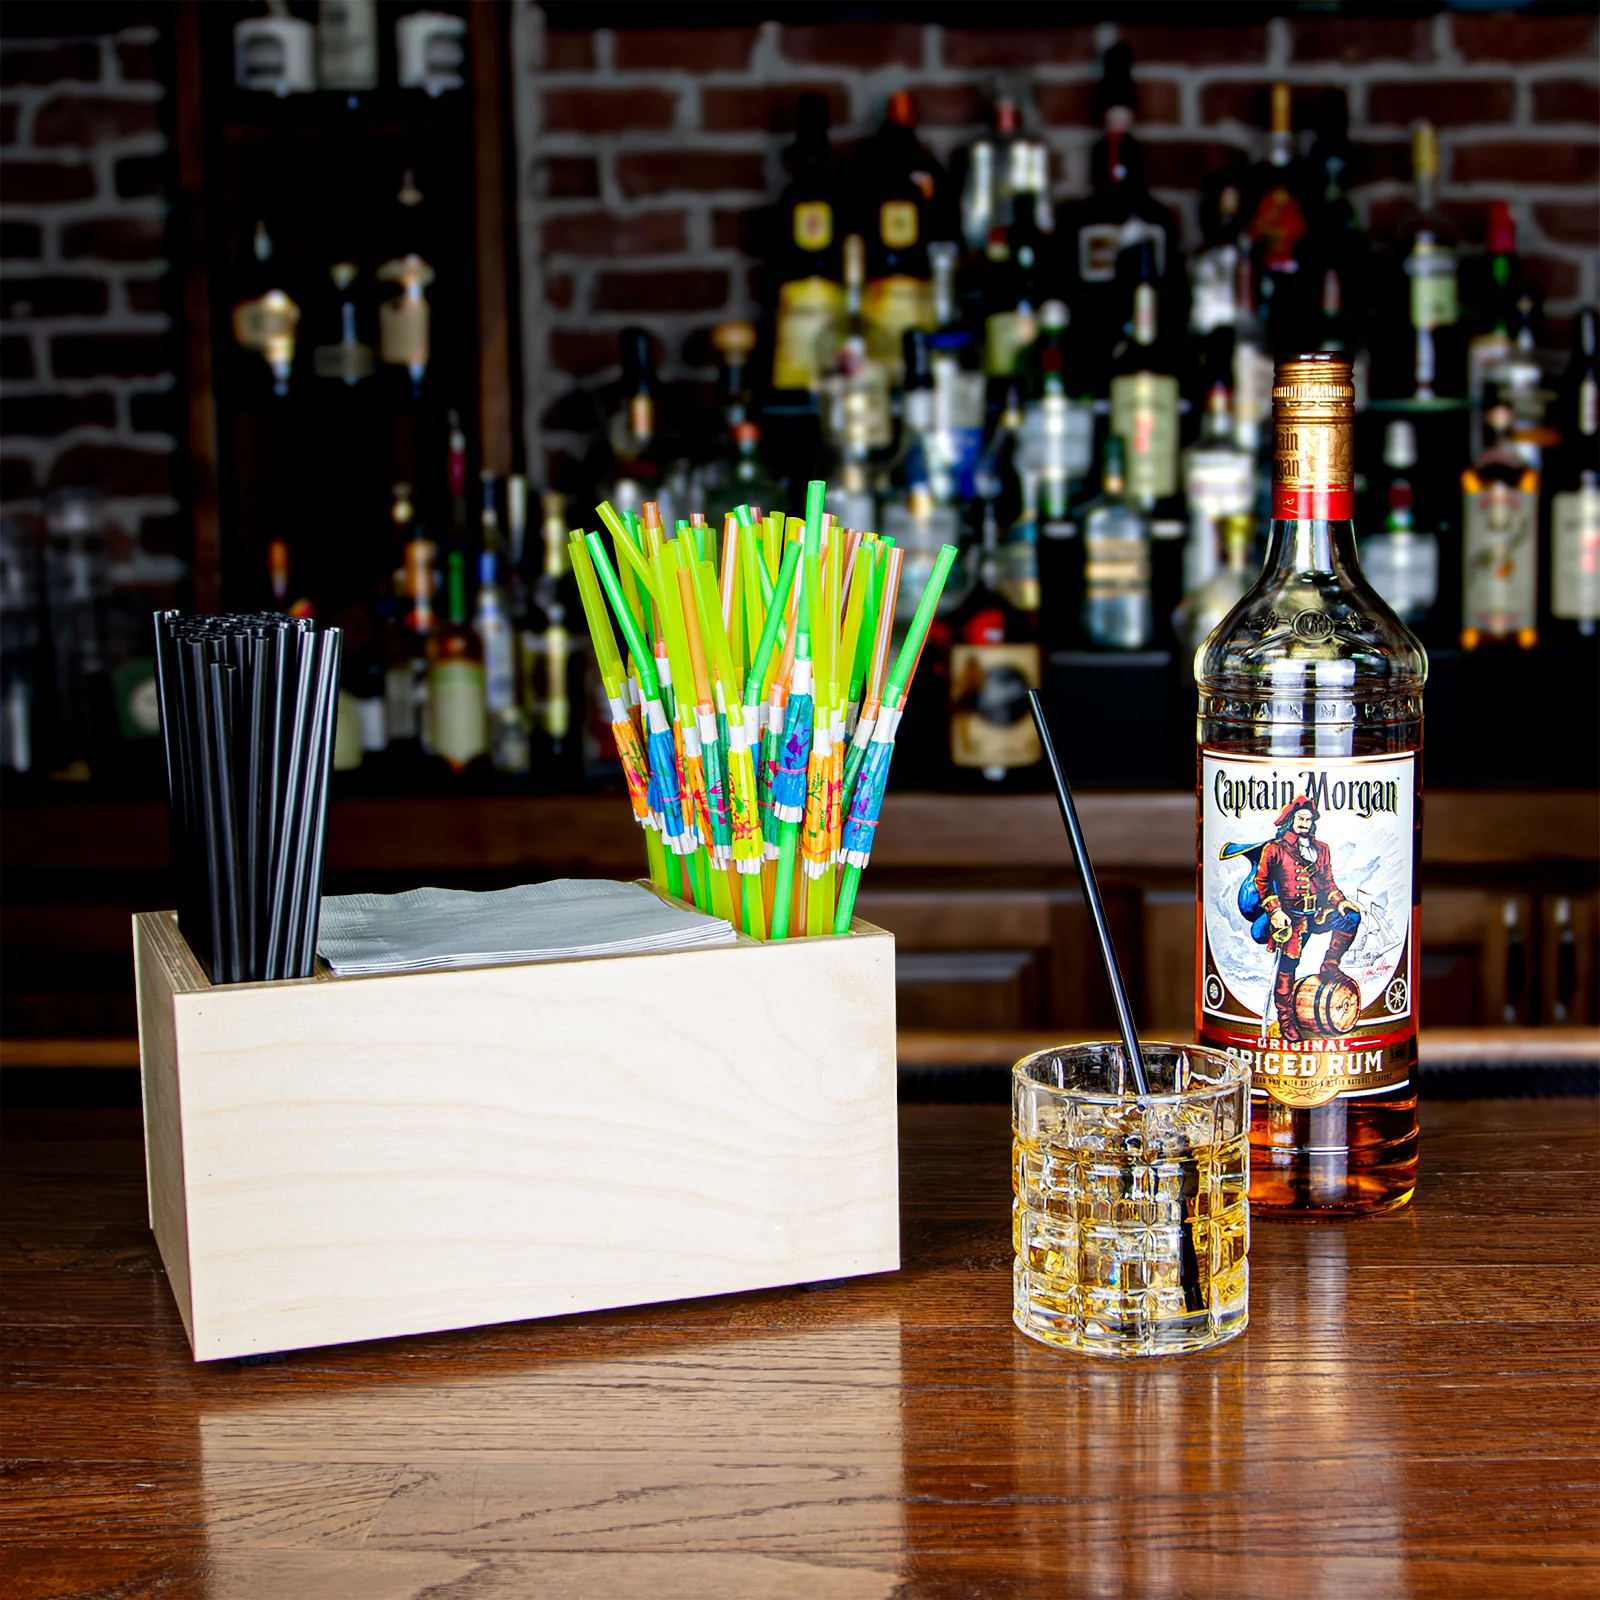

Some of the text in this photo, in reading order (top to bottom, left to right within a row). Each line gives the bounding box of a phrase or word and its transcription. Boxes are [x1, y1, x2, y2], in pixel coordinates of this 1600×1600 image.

[1214, 769, 1398, 819] Captain Morgan
[1257, 1037, 1350, 1052] ORIGINAL
[1327, 1050, 1384, 1077] RUM
